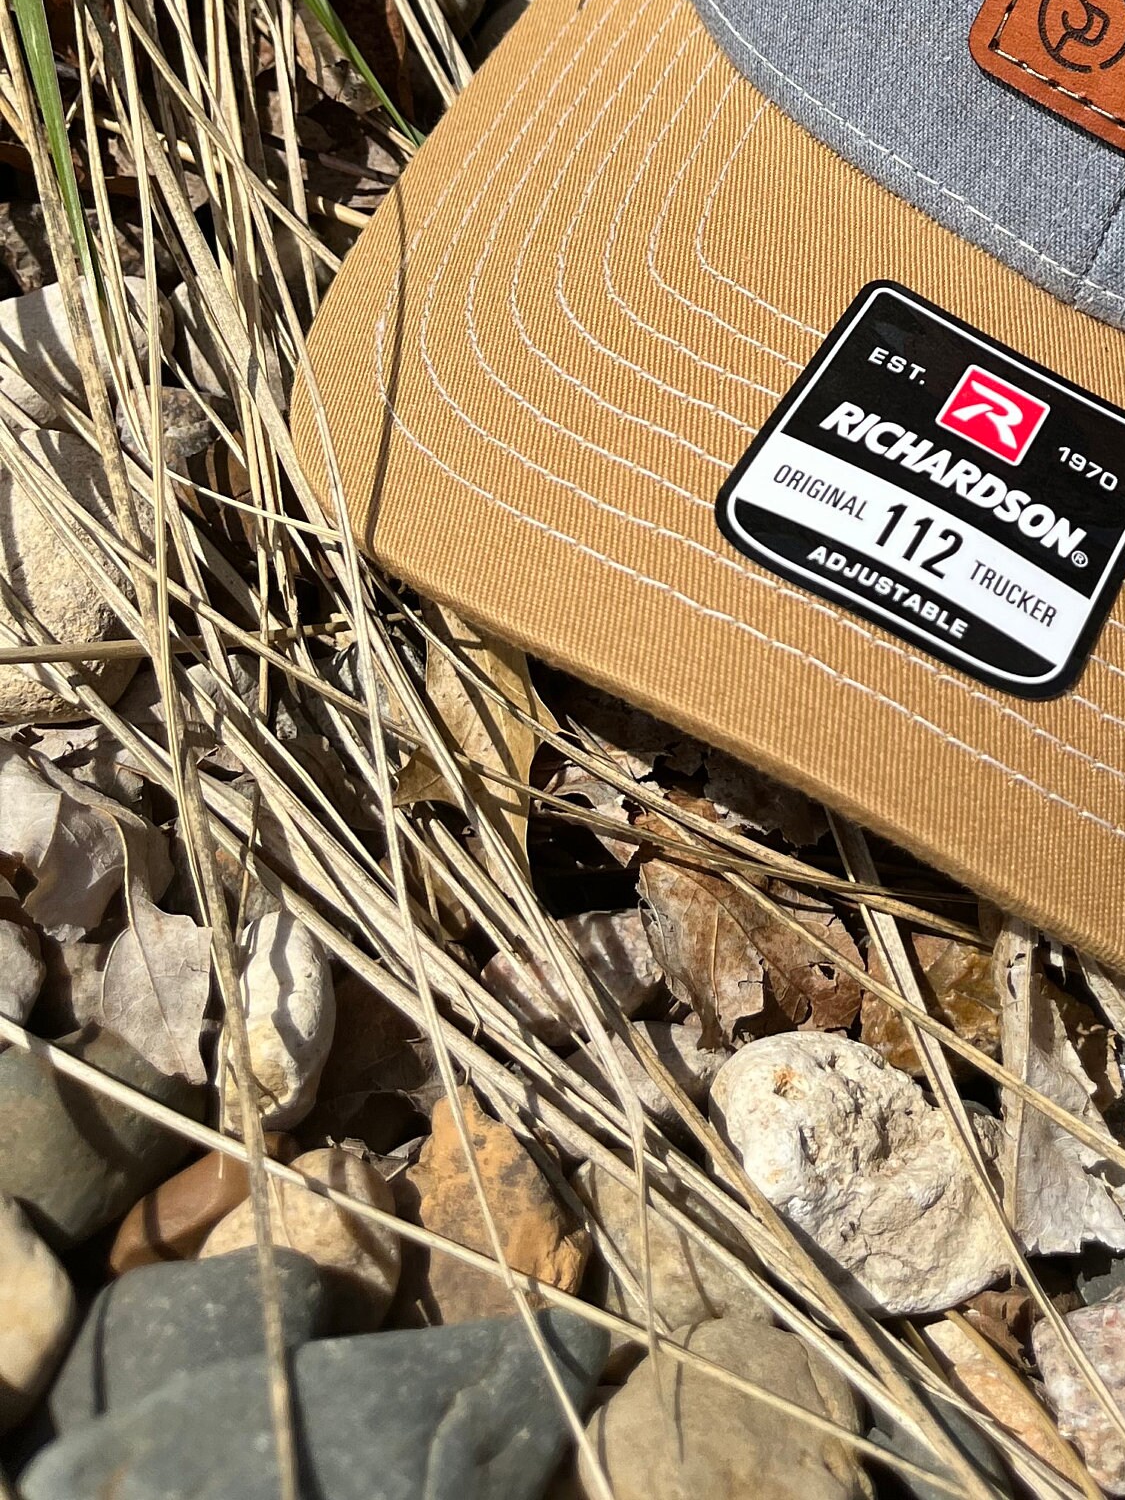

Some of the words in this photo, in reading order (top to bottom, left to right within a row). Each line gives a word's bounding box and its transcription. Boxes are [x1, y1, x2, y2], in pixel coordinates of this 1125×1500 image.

[868, 347, 927, 385] EST.
[1058, 446, 1119, 492] 1970
[773, 464, 869, 521] ORIGINAL
[874, 503, 964, 580] 112
[970, 560, 1058, 627] TRUCKER
[806, 545, 969, 640] ADJUSTABLE
